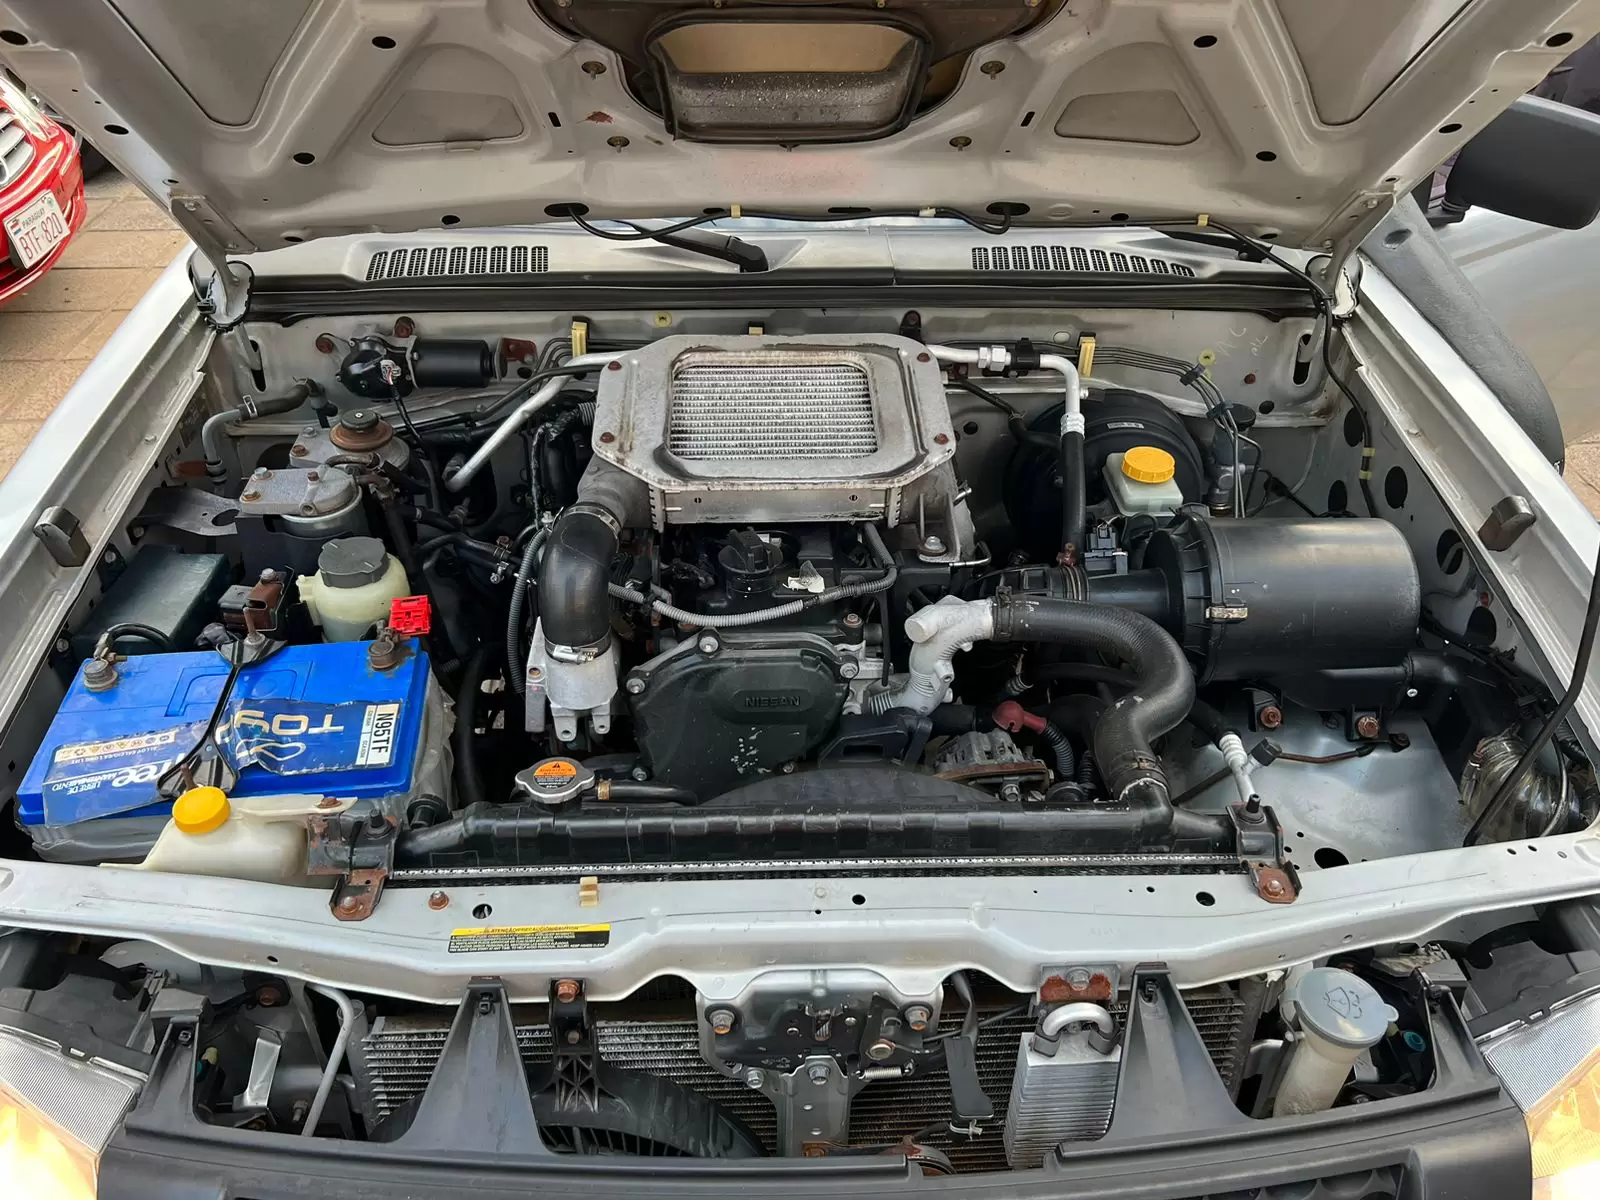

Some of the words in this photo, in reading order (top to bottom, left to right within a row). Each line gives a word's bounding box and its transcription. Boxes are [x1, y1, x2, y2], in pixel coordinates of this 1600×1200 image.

[22, 207, 45, 229] PARAGUAY
[19, 225, 42, 260] BTF
[41, 212, 63, 243] 820
[745, 695, 801, 707] NISSAN
[371, 712, 394, 753] N95TF
